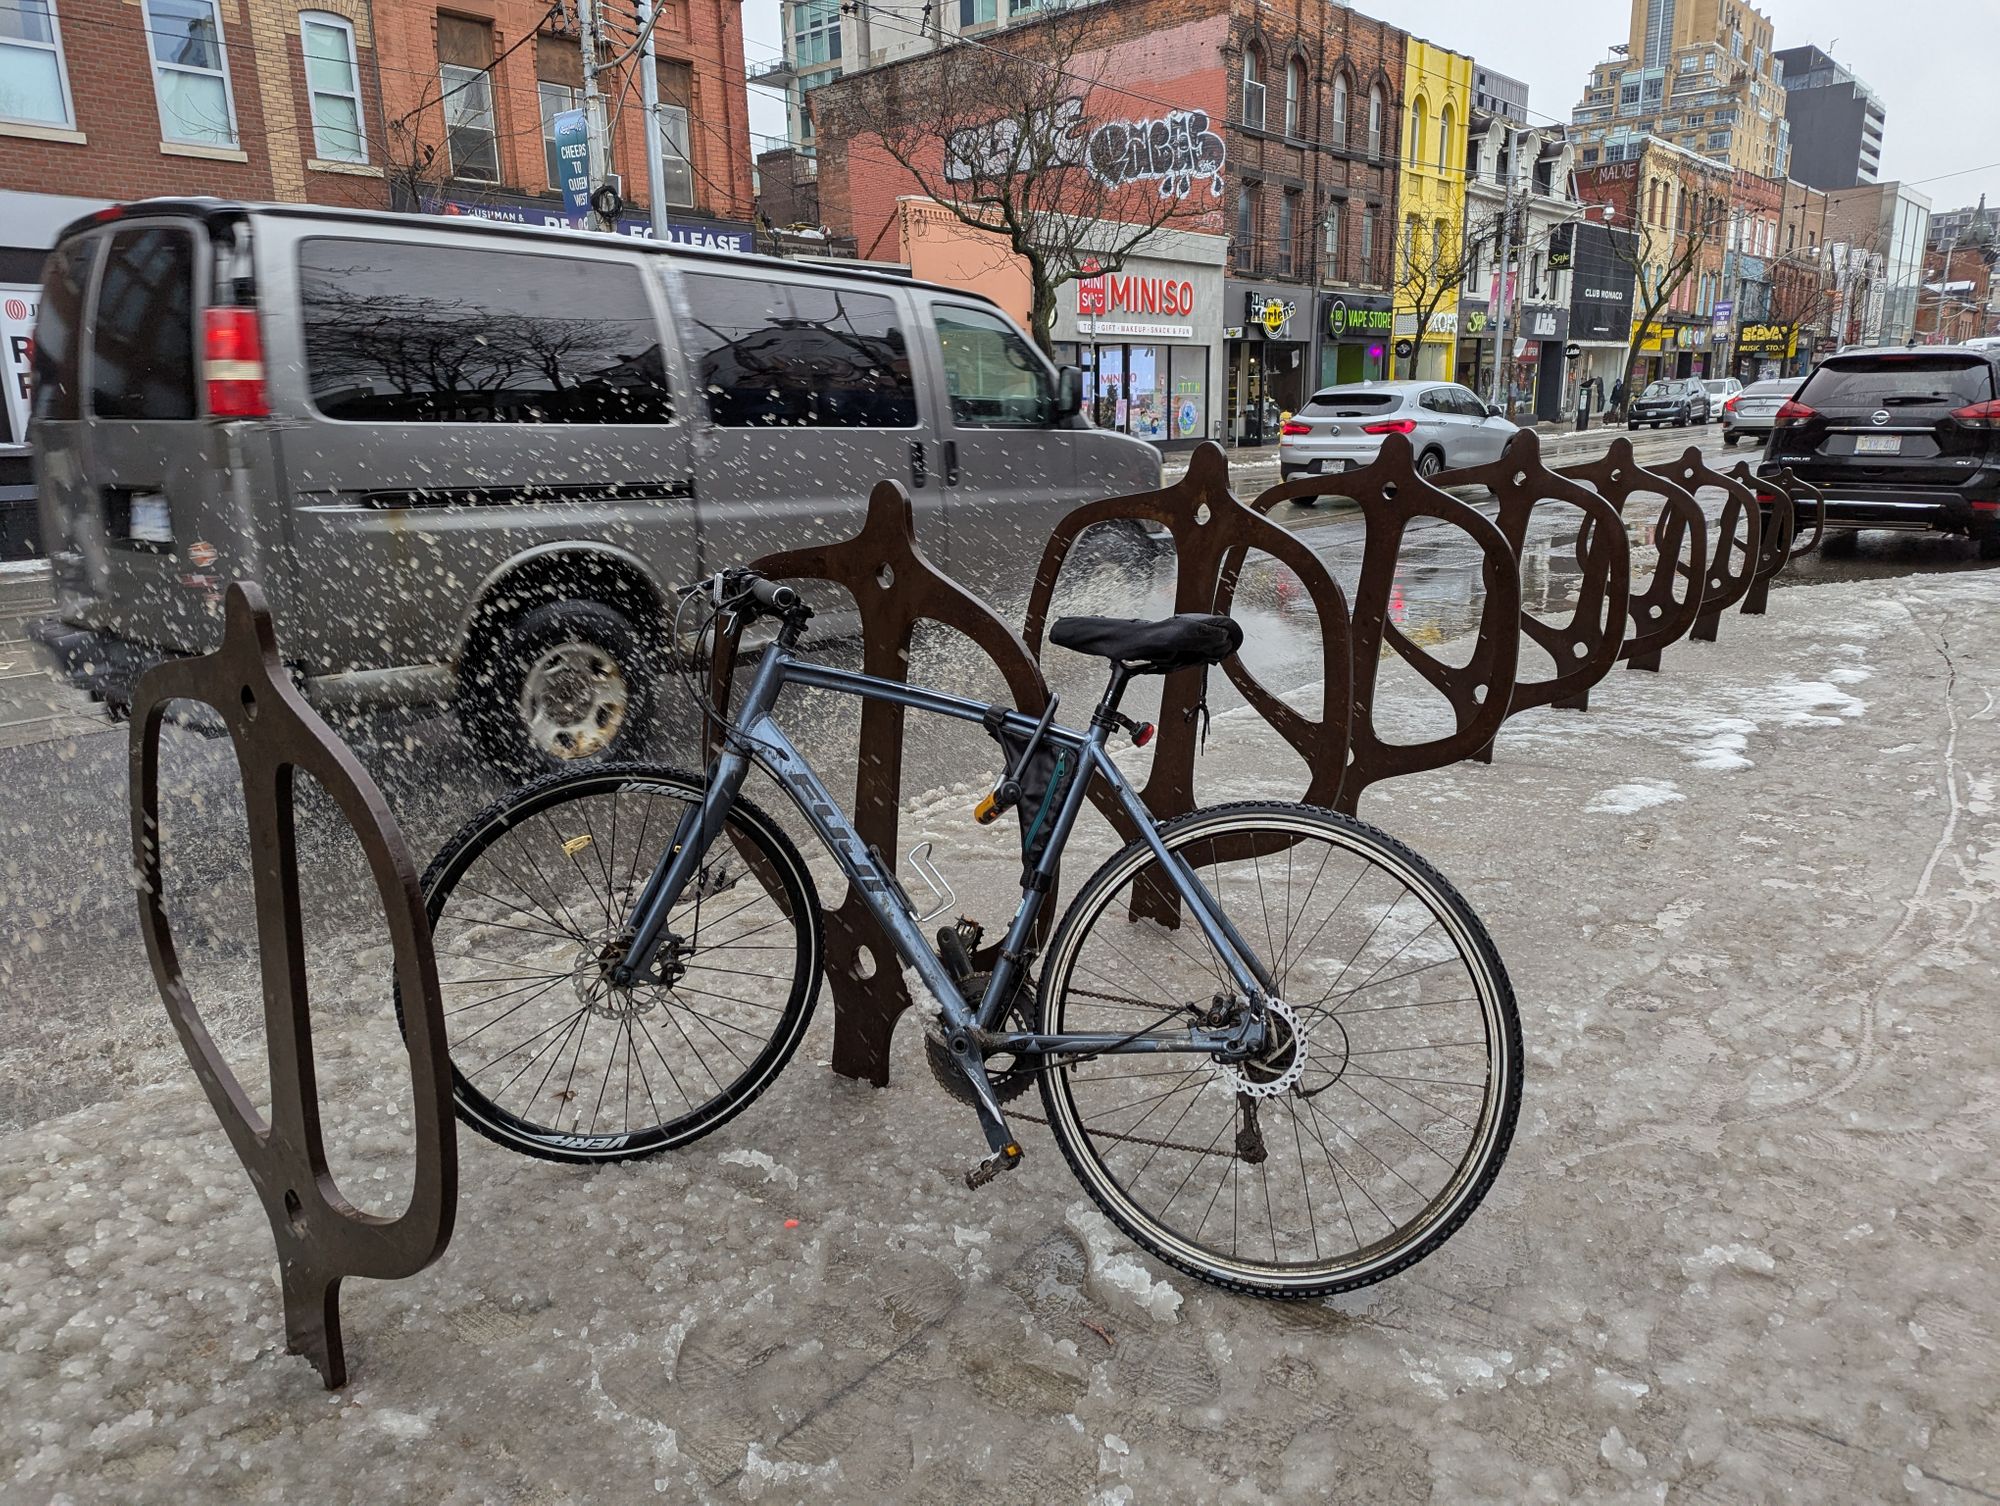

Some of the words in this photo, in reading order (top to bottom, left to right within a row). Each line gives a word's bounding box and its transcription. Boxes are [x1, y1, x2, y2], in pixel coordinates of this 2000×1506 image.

[561, 144, 586, 159] CHEERS
[572, 161, 581, 174] TO
[568, 176, 588, 191] QUEEN
[573, 193, 587, 207] WEST
[1108, 274, 1194, 316] MINISO
[1585, 288, 1600, 298] CLUB
[1601, 290, 1623, 300] MONACO
[1252, 301, 1296, 323] Martens
[1348, 309, 1367, 328] VAPE
[1369, 311, 1392, 329] STORE
[1533, 312, 1557, 336] Lids
[1101, 372, 1137, 385] MINO
[788, 774, 886, 892] FUJI
